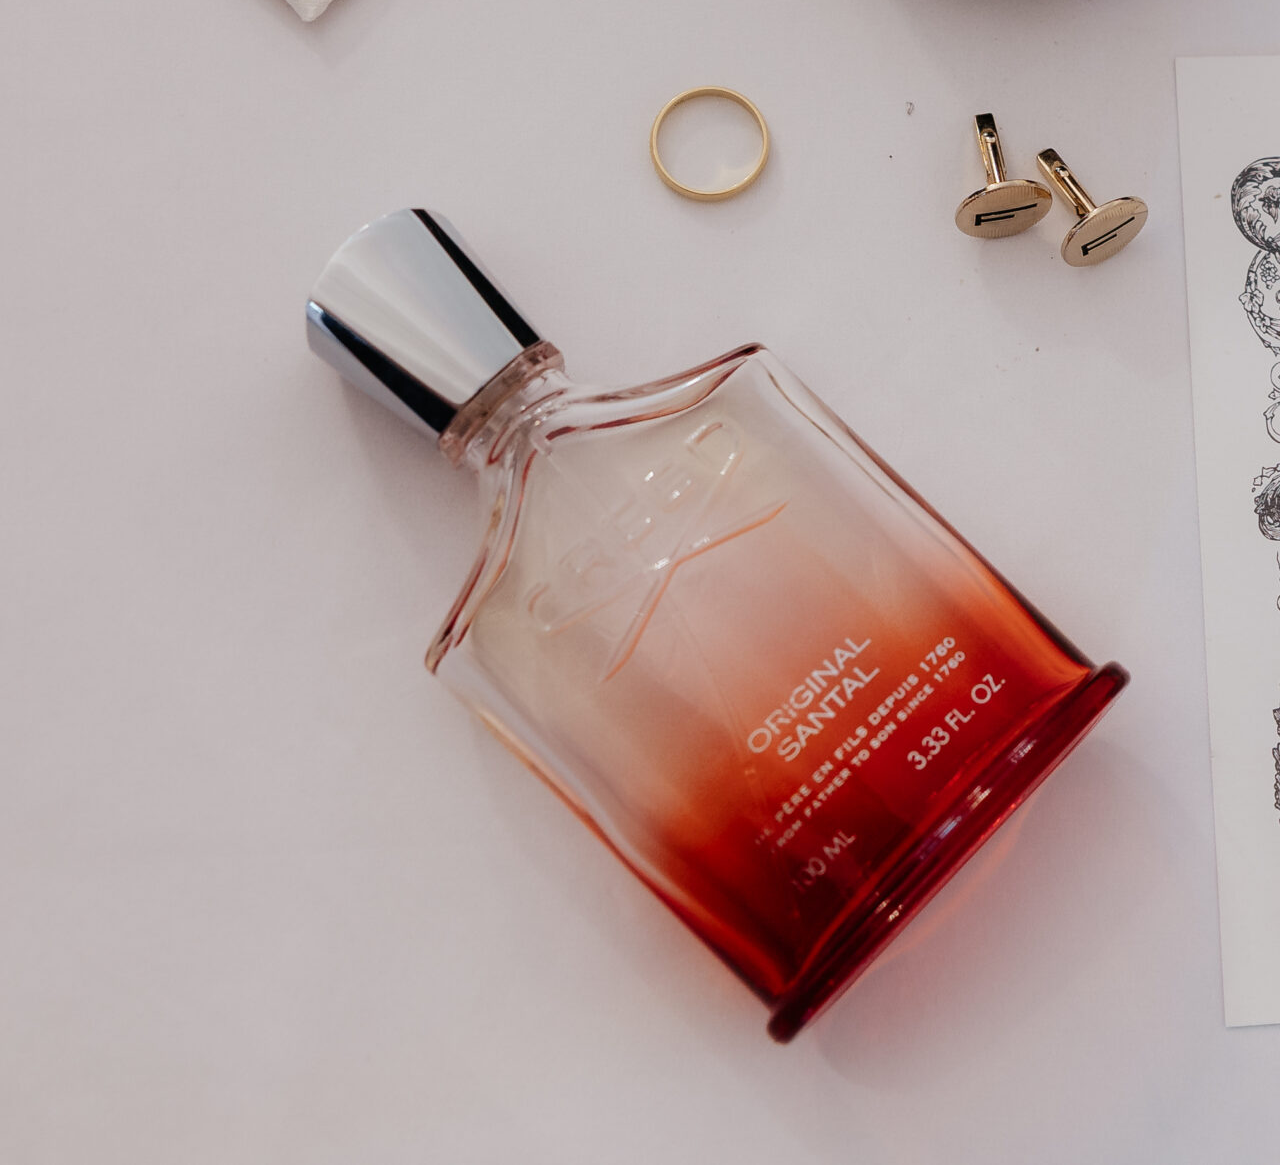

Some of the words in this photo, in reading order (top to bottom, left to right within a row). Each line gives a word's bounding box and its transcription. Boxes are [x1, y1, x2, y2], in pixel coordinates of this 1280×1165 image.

[747, 637, 872, 754] ORIGINAL
[777, 666, 880, 763] SANTAL
[804, 767, 852, 818] FATHER
[850, 749, 871, 768] TO
[869, 721, 898, 750] SON
[896, 683, 935, 722] SINCE
[933, 650, 966, 683] 1760
[811, 760, 834, 786] EN
[834, 725, 869, 761] FILS
[868, 674, 920, 726] DEPUIS
[919, 636, 956, 672] 1760
[907, 726, 951, 771] 3.33
[944, 707, 977, 732] FL.
[970, 673, 1006, 705] OZ.
[823, 829, 857, 861] ML
